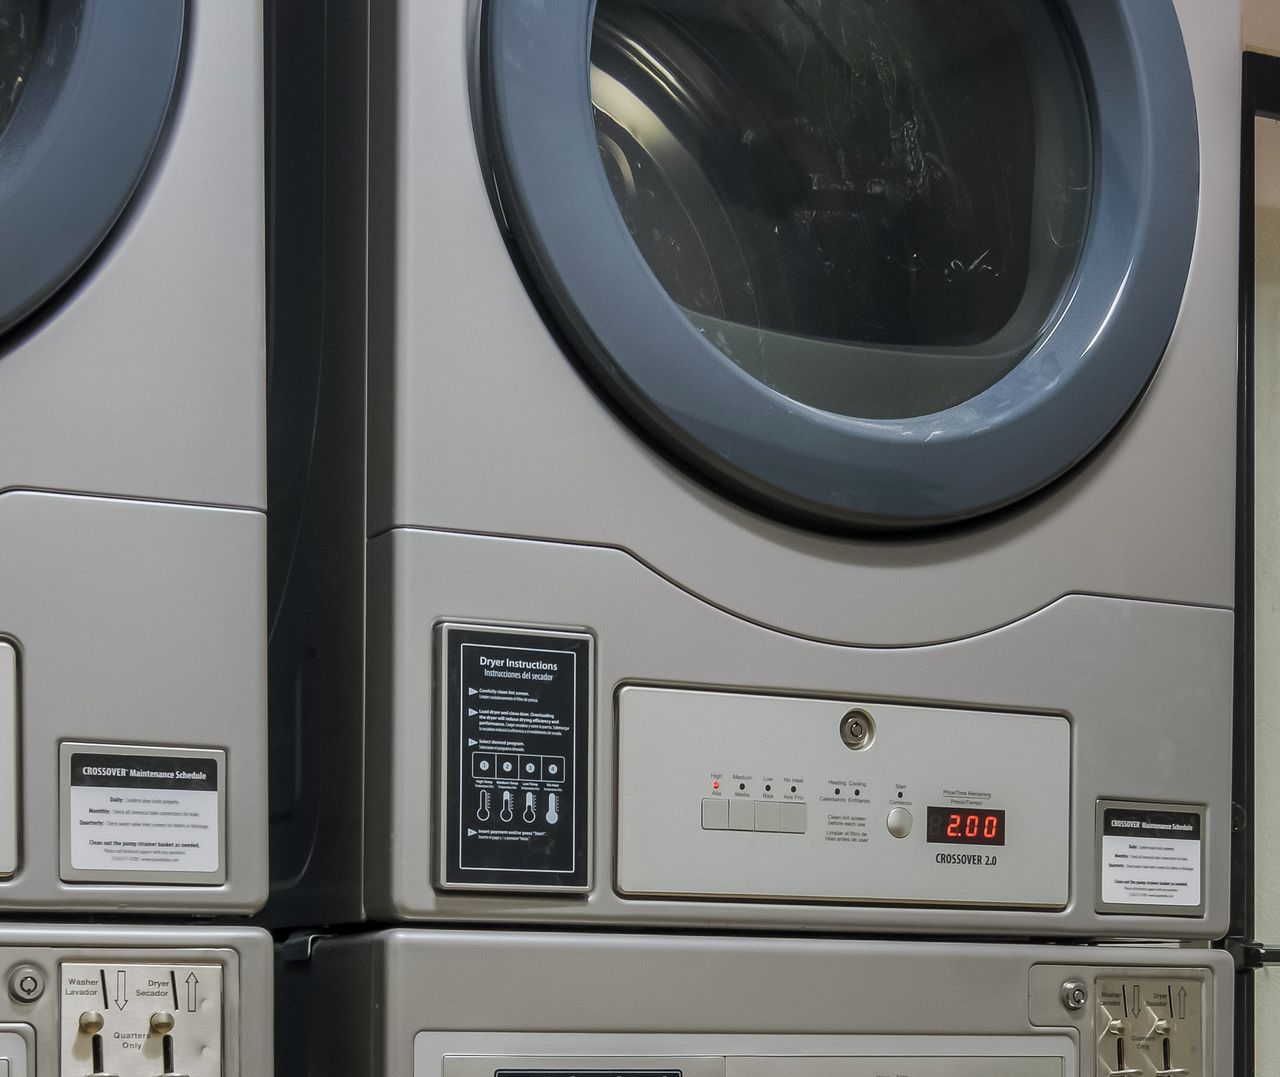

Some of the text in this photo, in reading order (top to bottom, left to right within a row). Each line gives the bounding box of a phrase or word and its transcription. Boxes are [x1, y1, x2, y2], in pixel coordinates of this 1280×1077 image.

[479, 656, 558, 671] Dryer Instructions
[484, 669, 554, 681] Instrucciones del secador
[129, 769, 174, 779] Maintenance
[175, 770, 207, 780] Schedule
[947, 814, 997, 838] 2.00
[935, 853, 997, 866] CROSSOVER 2.0
[68, 978, 99, 986] Washer
[148, 979, 170, 988] Dryer
[135, 989, 169, 997] Secador
[113, 1031, 151, 1040] Quarters
[122, 1042, 142, 1050] Only
